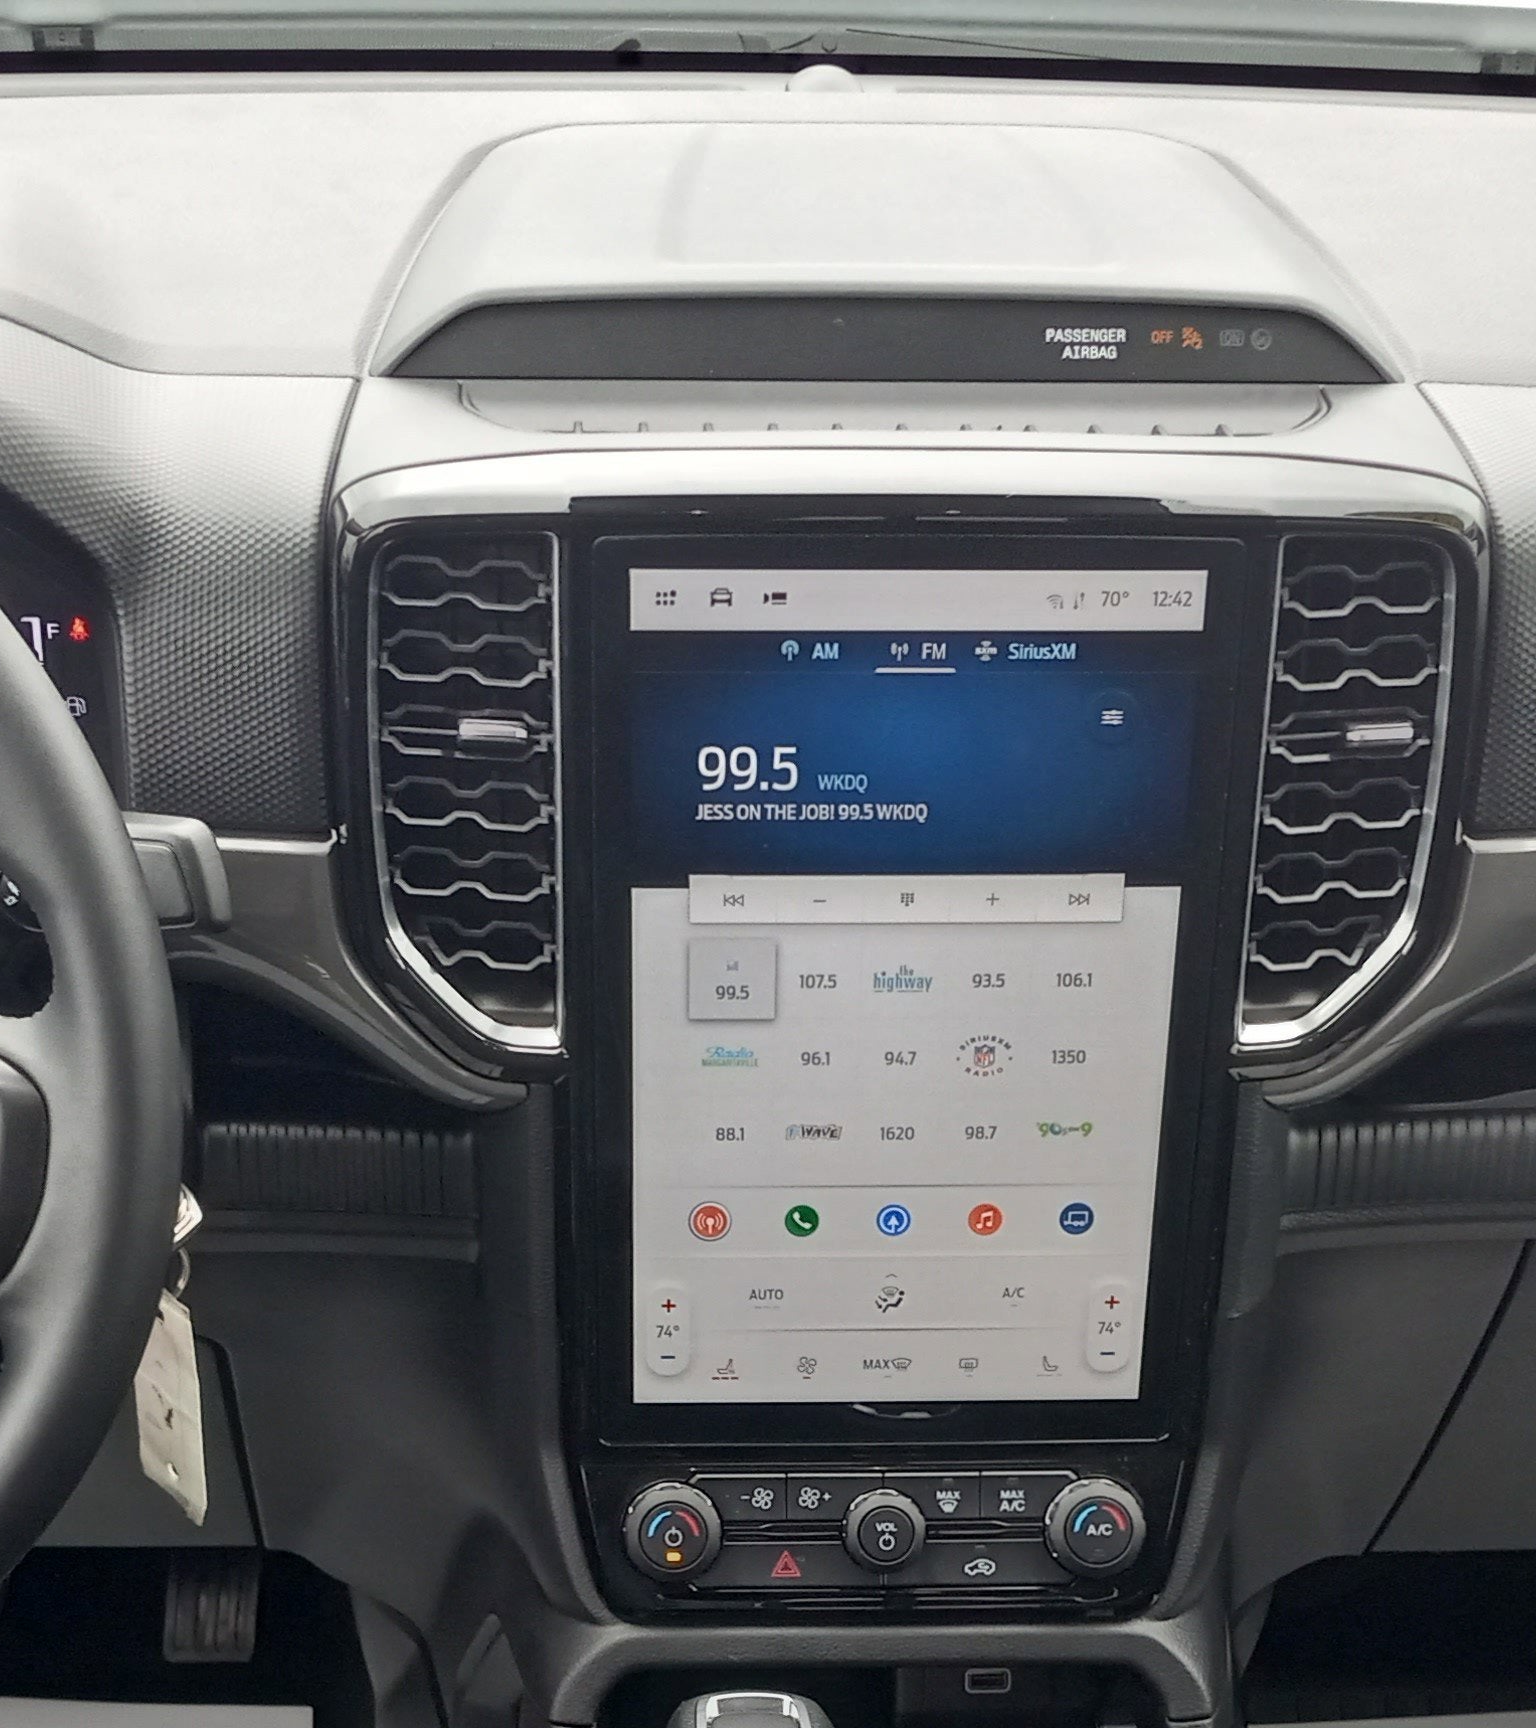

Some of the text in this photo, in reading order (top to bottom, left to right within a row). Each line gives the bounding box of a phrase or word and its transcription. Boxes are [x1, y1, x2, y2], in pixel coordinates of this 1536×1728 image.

[1044, 328, 1127, 343] PASSENGER
[1150, 330, 1174, 344] OFF
[1061, 345, 1118, 360] AIRBAG
[1101, 590, 1131, 608] 70°
[1152, 590, 1193, 608] 12:42
[47, 623, 60, 639] F
[812, 643, 839, 660] AM
[922, 643, 947, 660] FM
[1007, 643, 1077, 660] SiriusXM
[697, 745, 868, 795] 99.5 WKDQ
[695, 803, 929, 823] JESS ON THE JOB! 99.5 WKDQ
[799, 974, 837, 989] 107.5
[873, 971, 933, 993] highway
[972, 972, 1006, 989] 93.5
[1055, 972, 1094, 989] 106.1
[715, 984, 750, 1000] 99.5
[801, 1051, 831, 1066] 96.1
[884, 1051, 917, 1066] 94.7
[1051, 1050, 1087, 1064] 1350
[715, 1126, 745, 1142] 88.1
[880, 1126, 915, 1140] 1620
[965, 1125, 998, 1140] 98.7
[749, 1288, 785, 1302] AUTO
[1002, 1286, 1025, 1300] A/C
[656, 1324, 680, 1339] 74°
[1098, 1320, 1122, 1335] 74°
[863, 1358, 891, 1371] MAX
[936, 1489, 962, 1500] MAX
[1000, 1489, 1025, 1500] MAX
[999, 1500, 1026, 1512] A/C
[876, 1522, 898, 1533] VOL
[1086, 1524, 1113, 1537] A/C
